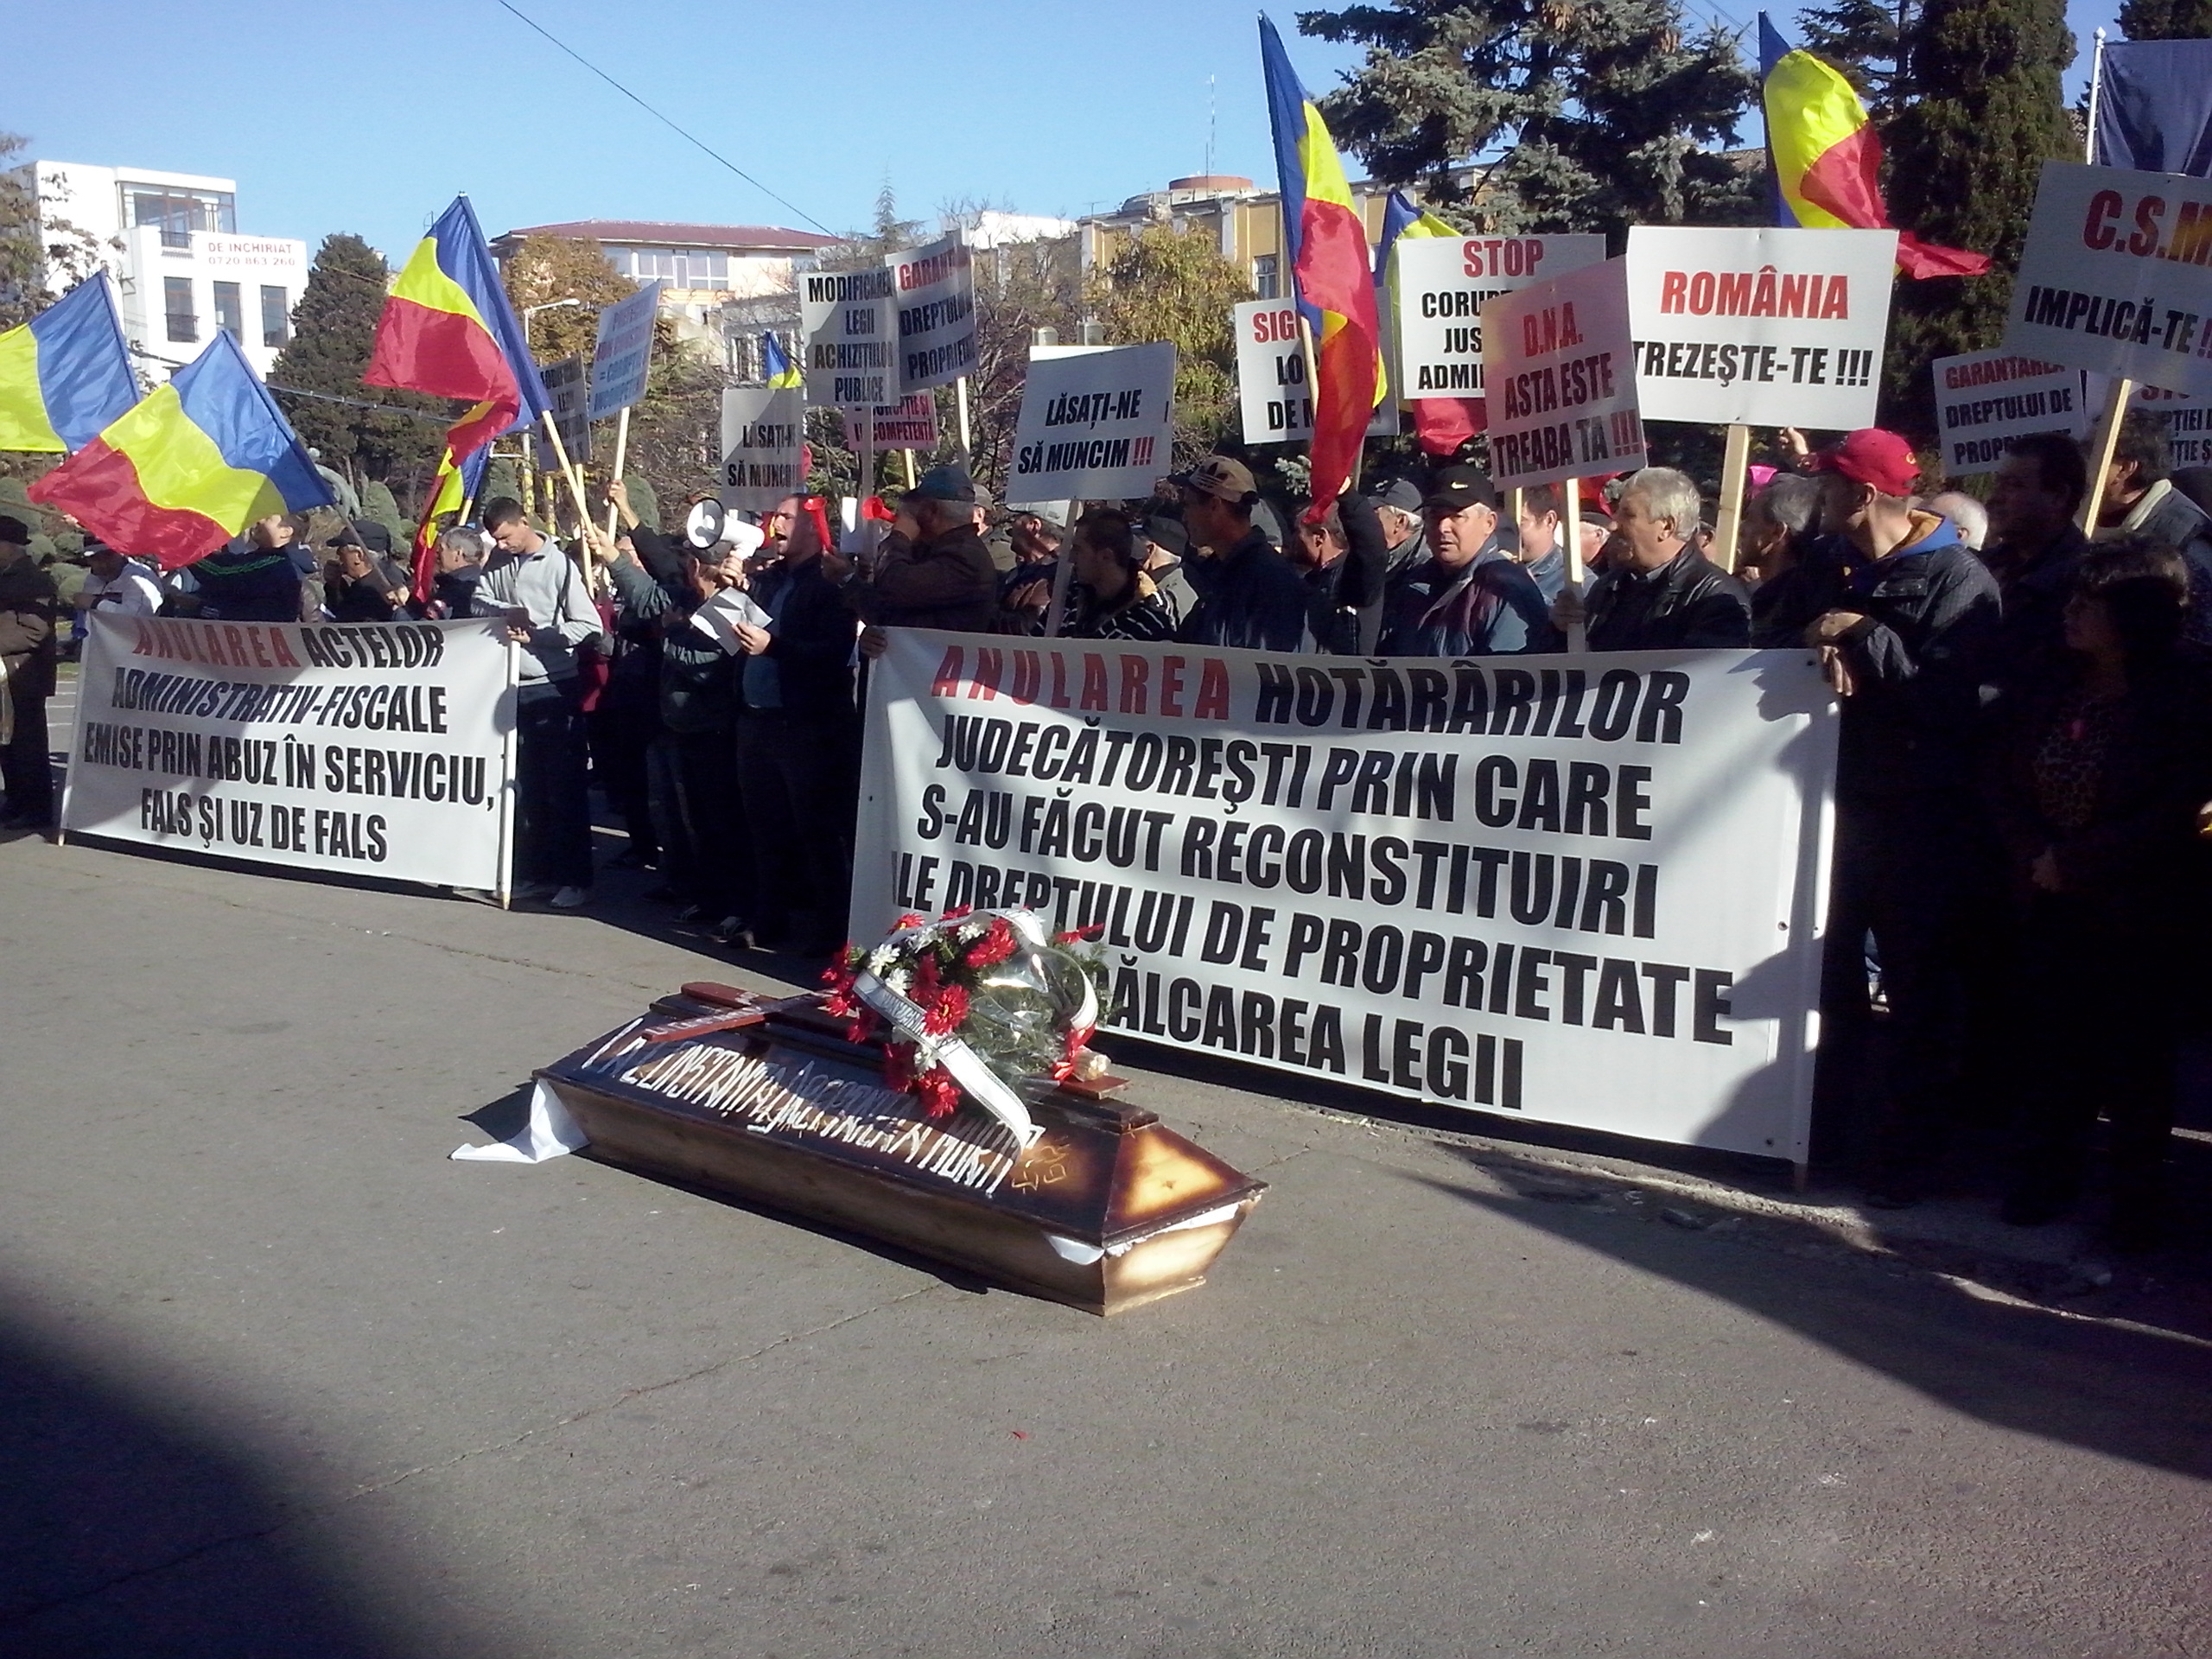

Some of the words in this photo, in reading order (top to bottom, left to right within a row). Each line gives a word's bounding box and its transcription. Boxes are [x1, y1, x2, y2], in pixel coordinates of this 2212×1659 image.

[208, 243, 224, 252] DE
[229, 243, 292, 254] INCHIRIAT
[208, 257, 240, 265] 0720
[1462, 238, 1544, 277] STOP
[1660, 264, 1848, 320] ROMÂNIA
[2024, 285, 2199, 354] IMPLICĂ-TE
[845, 308, 874, 335] LEGII
[1522, 302, 1584, 358] D.N.A.
[835, 377, 884, 402] PUBLICE
[1505, 366, 1558, 421] ASTA
[1560, 353, 1615, 407] ESTE
[1835, 349, 1873, 386] !!!
[1267, 398, 1297, 430] DE
[1945, 391, 2046, 429] DREPTULUI
[2050, 388, 2072, 414] DE
[1018, 440, 1044, 474] SĂ
[1046, 438, 1130, 473] MUNCIM
[1133, 436, 1154, 466] !!!
[1492, 423, 1574, 478] TREABA
[1576, 415, 1609, 462] TA
[1610, 409, 1641, 457] !!!
[728, 460, 746, 486] SĂ
[132, 617, 300, 667] ANULAREA
[300, 626, 445, 668] ACTELOR
[112, 668, 448, 734] ADMINISTRATIV-FISCALE
[931, 645, 1230, 720] ANULAREA
[1255, 659, 1691, 745] HOTĂRÂRILOR
[84, 723, 143, 769] EMISE
[149, 731, 201, 777] PRIN
[207, 736, 278, 785] ABUZ
[283, 734, 315, 789] ÎN
[325, 745, 495, 811] SERVICIU,
[1316, 747, 1459, 822] PRIN
[1474, 754, 1653, 841] CARE
[141, 788, 191, 836] FALS
[231, 800, 263, 847] UZ
[271, 805, 306, 853] DE
[315, 809, 388, 862] FALS
[918, 784, 1013, 849] S-AU
[1020, 787, 1175, 871] FĂCUT
[1180, 816, 1659, 940] RECONSTITUIRI
[944, 860, 1194, 957] DREPTULUI
[1200, 899, 1276, 974] DE
[1283, 912, 1733, 1046] PROPRIETATE
[1096, 954, 1346, 1075] ĂLCAREA
[1362, 1013, 1524, 1111] LEGII
